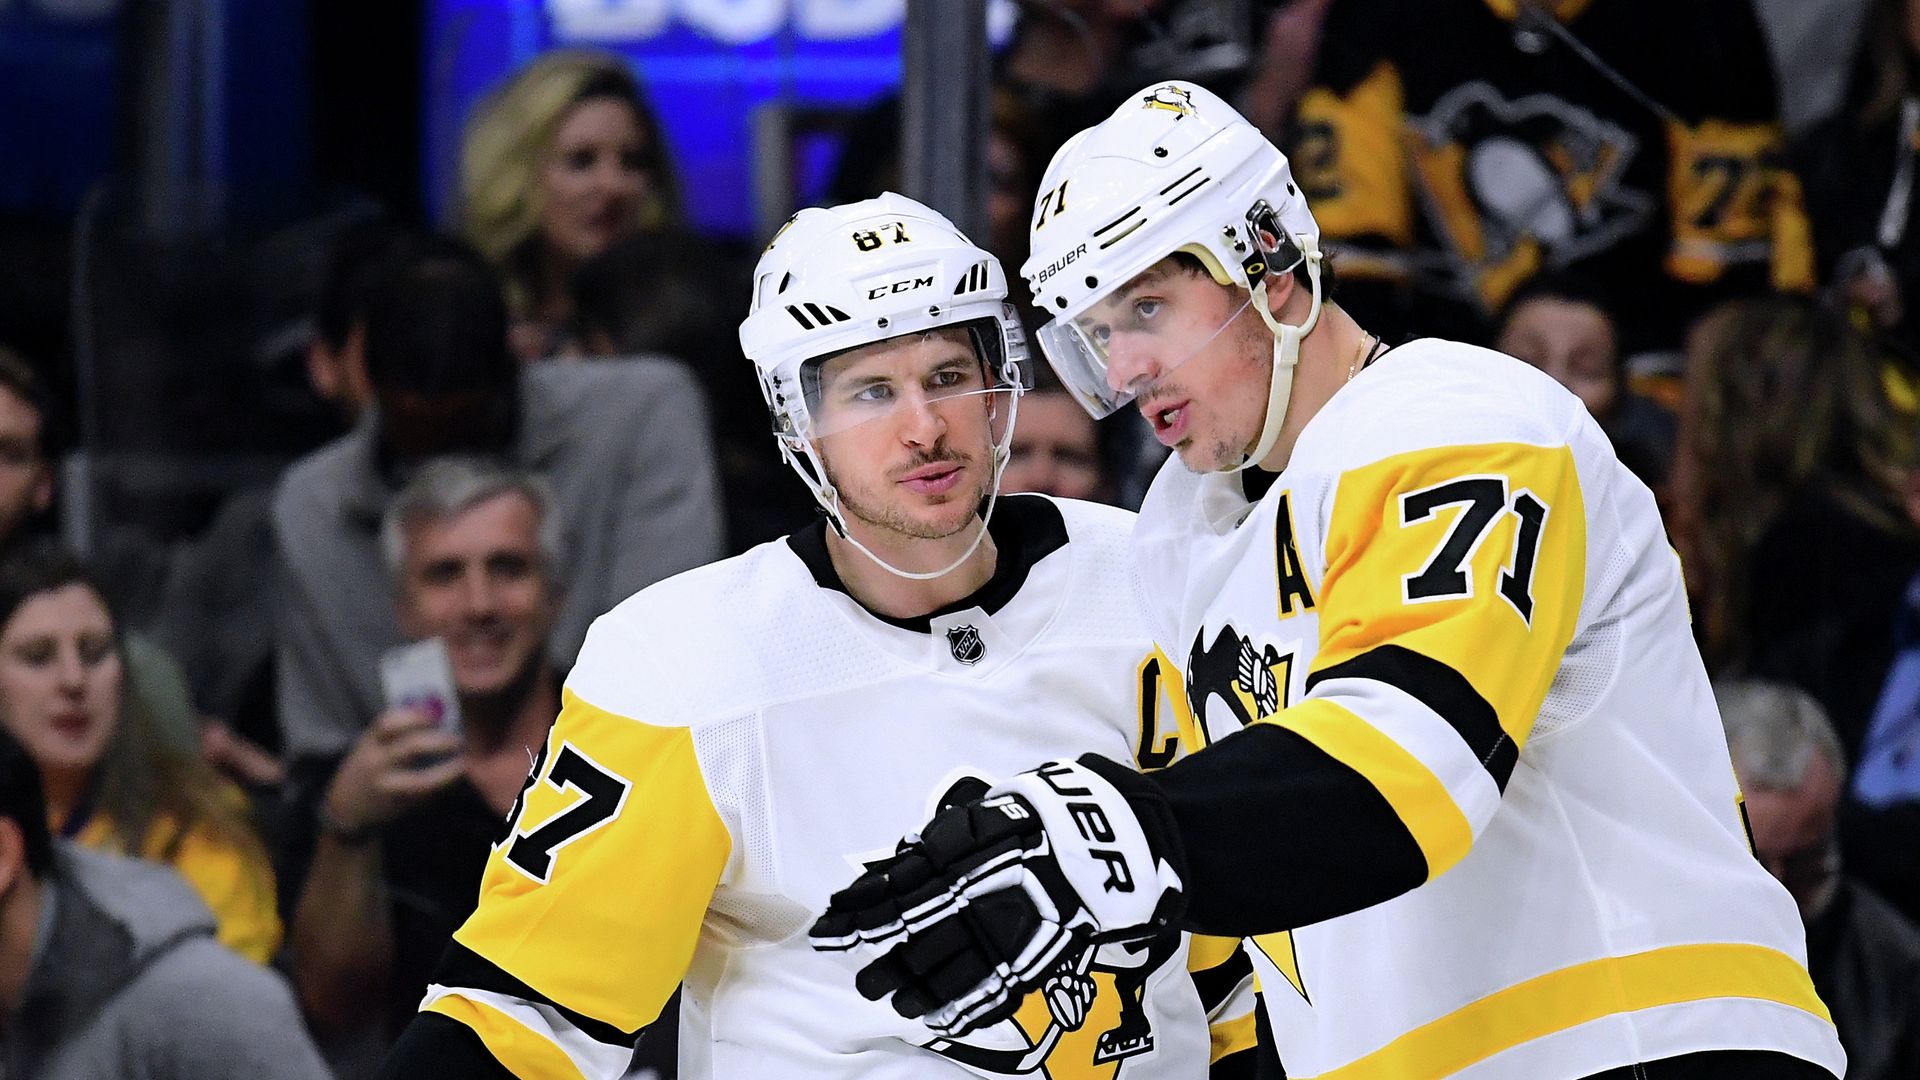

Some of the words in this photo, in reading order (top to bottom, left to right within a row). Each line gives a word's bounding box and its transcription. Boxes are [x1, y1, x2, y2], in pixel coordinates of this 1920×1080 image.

[1034, 178, 1070, 232] 71
[852, 220, 913, 252] 87
[1038, 242, 1088, 284] BAUER
[867, 275, 934, 301] CCM
[1274, 489, 1319, 620] A
[1399, 474, 1551, 632] 71
[957, 634, 976, 659] NHL
[1134, 652, 1181, 775] C
[1036, 761, 1136, 895] UER
